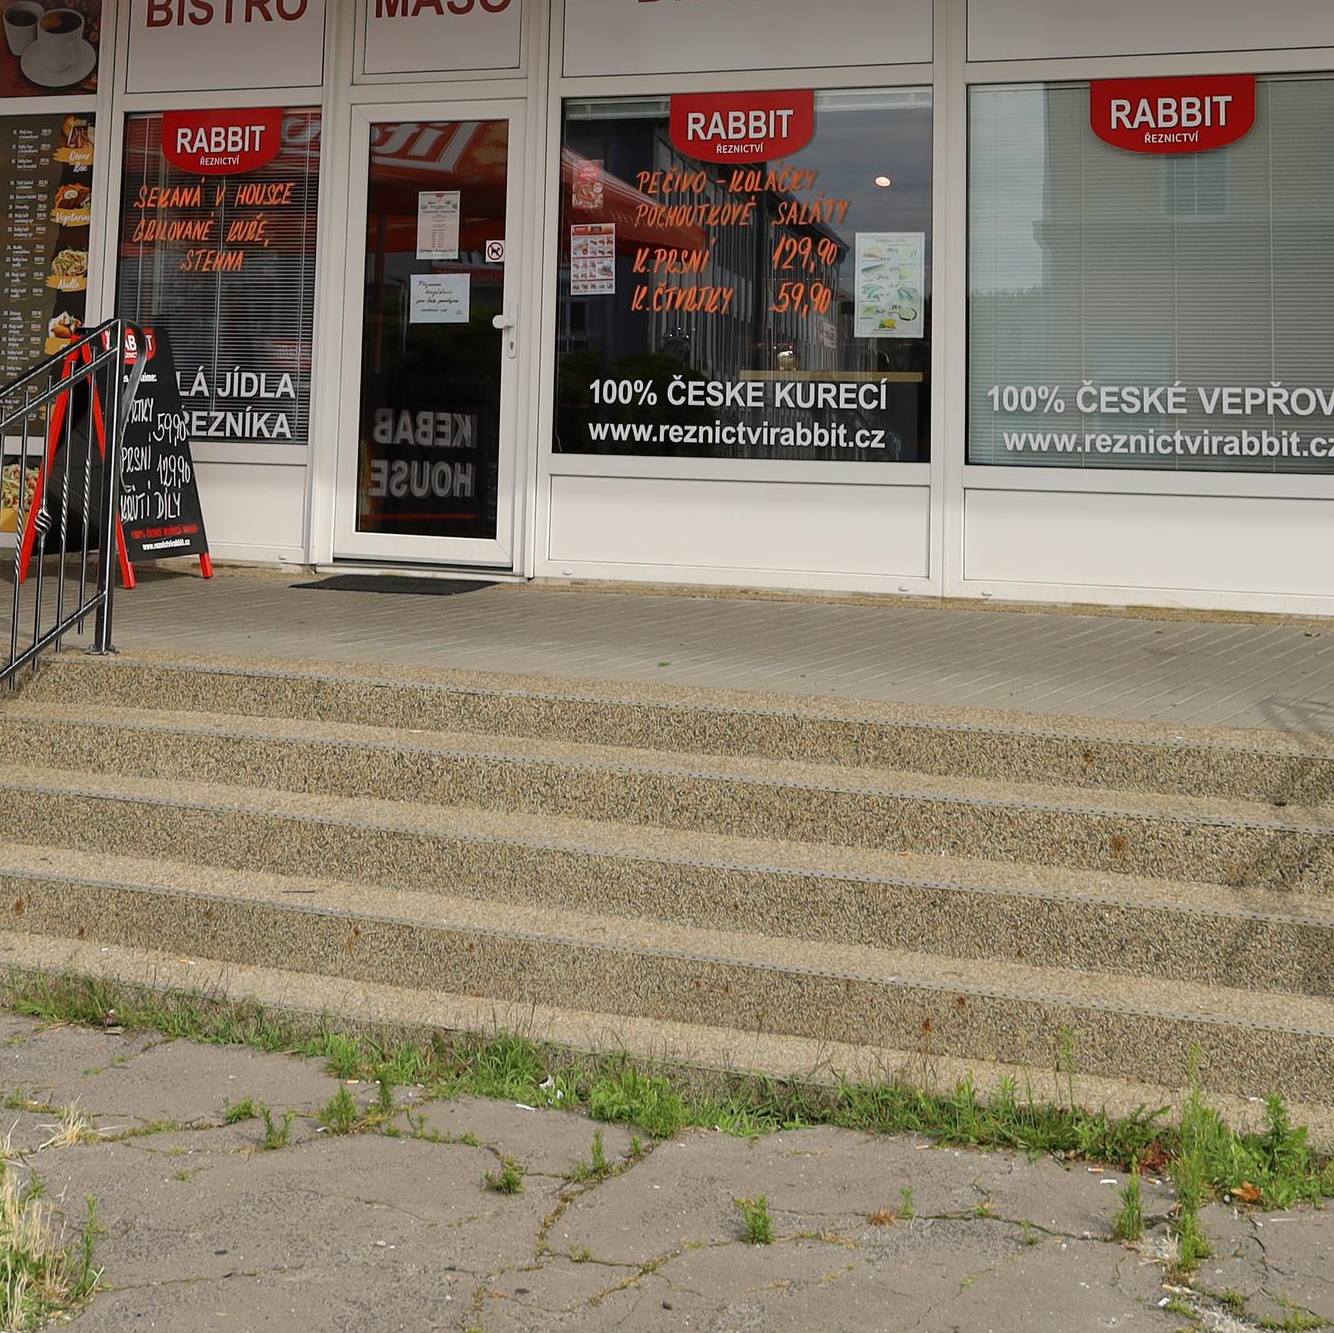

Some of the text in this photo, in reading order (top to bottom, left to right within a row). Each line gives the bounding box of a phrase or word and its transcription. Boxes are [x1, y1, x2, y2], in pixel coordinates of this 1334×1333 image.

[687, 109, 794, 141] RABBIT
[1110, 94, 1233, 130] RABBIT
[176, 125, 266, 154] RABBIT
[716, 142, 764, 154] ŘEZNICTVÍ
[1144, 131, 1199, 145] ŘEZNICTVÍ
[199, 155, 240, 166] ŘEZNICTVÍ
[133, 176, 205, 208] SEKANÁ
[235, 182, 296, 207] HOUSCE
[634, 192, 851, 227] POCHOUTKOVÉ SALÁTY
[180, 249, 244, 272] STEHNA
[217, 366, 296, 399] JÍDLA
[589, 378, 658, 406] 100%
[987, 385, 1065, 414] 100%
[1076, 379, 1187, 415] ČESKÉ
[588, 420, 886, 449] www.reznictvirabbit.cz
